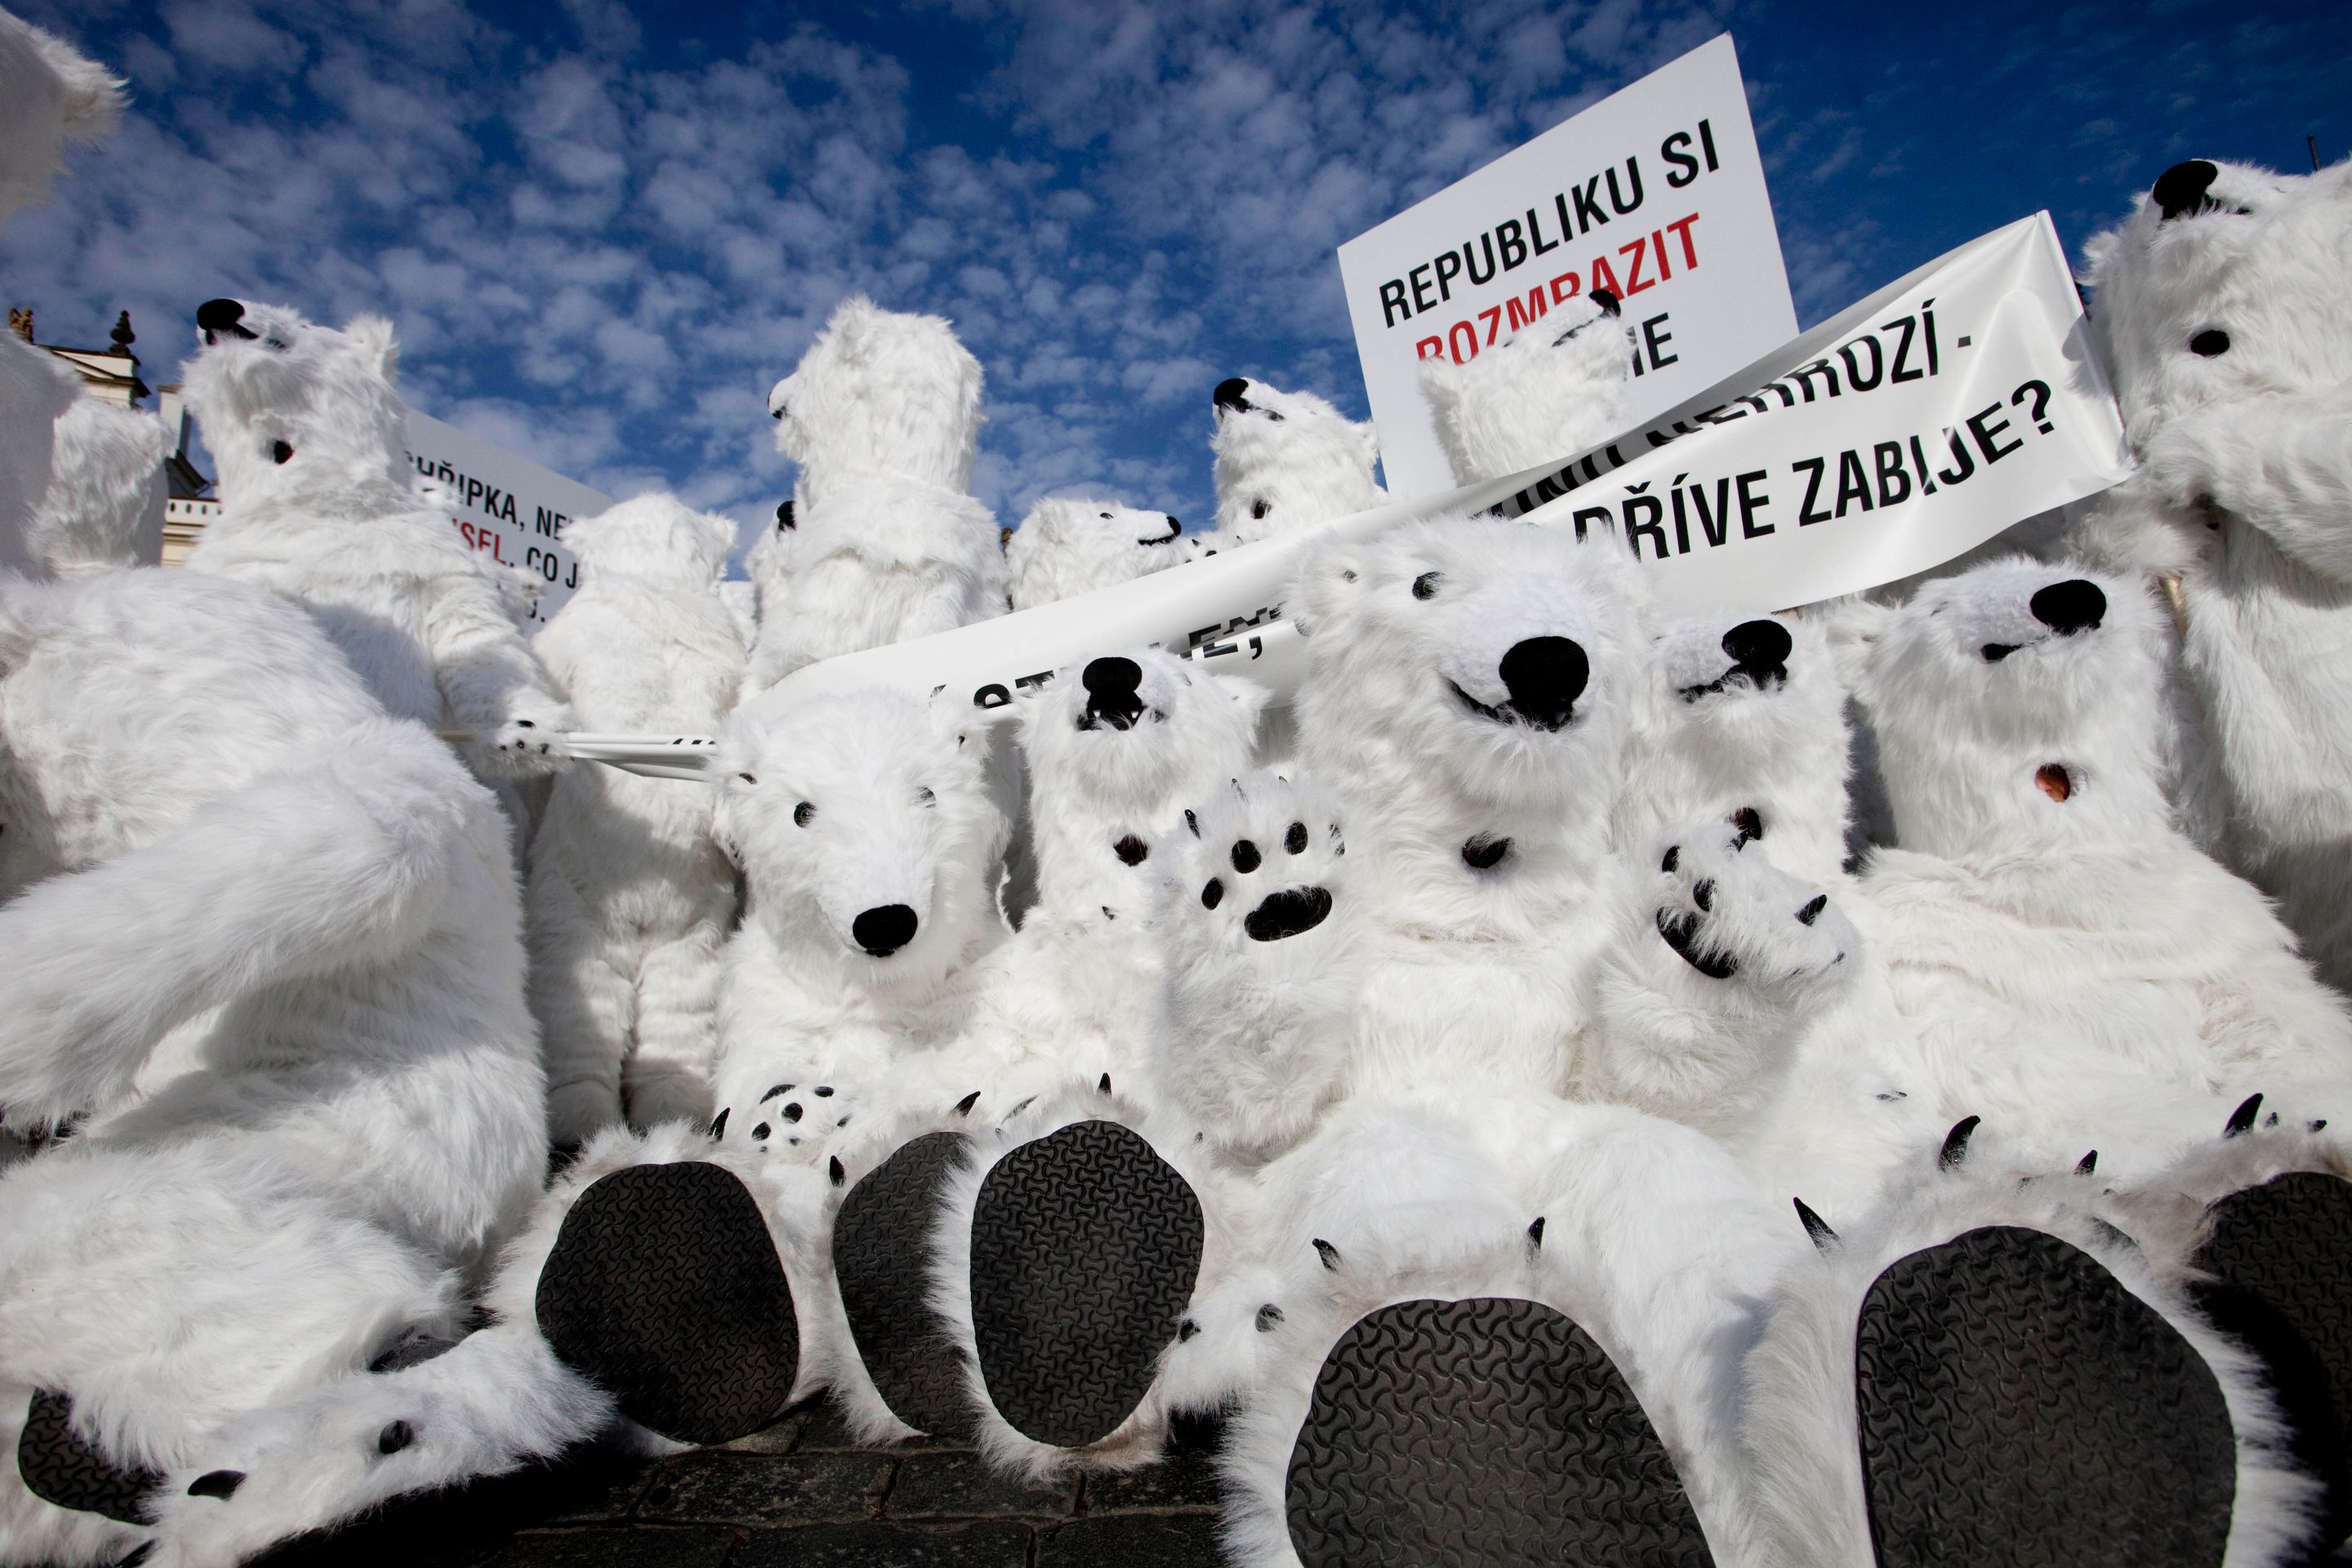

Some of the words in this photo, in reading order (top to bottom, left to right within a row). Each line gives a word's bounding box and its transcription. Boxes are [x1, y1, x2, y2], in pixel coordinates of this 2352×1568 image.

[1379, 155, 1644, 328] REPUBLIKU
[1661, 118, 1719, 189] SI
[1792, 380, 2055, 527] ZABIJE?
[527, 546, 557, 582] CO
[536, 506, 573, 541] NE
